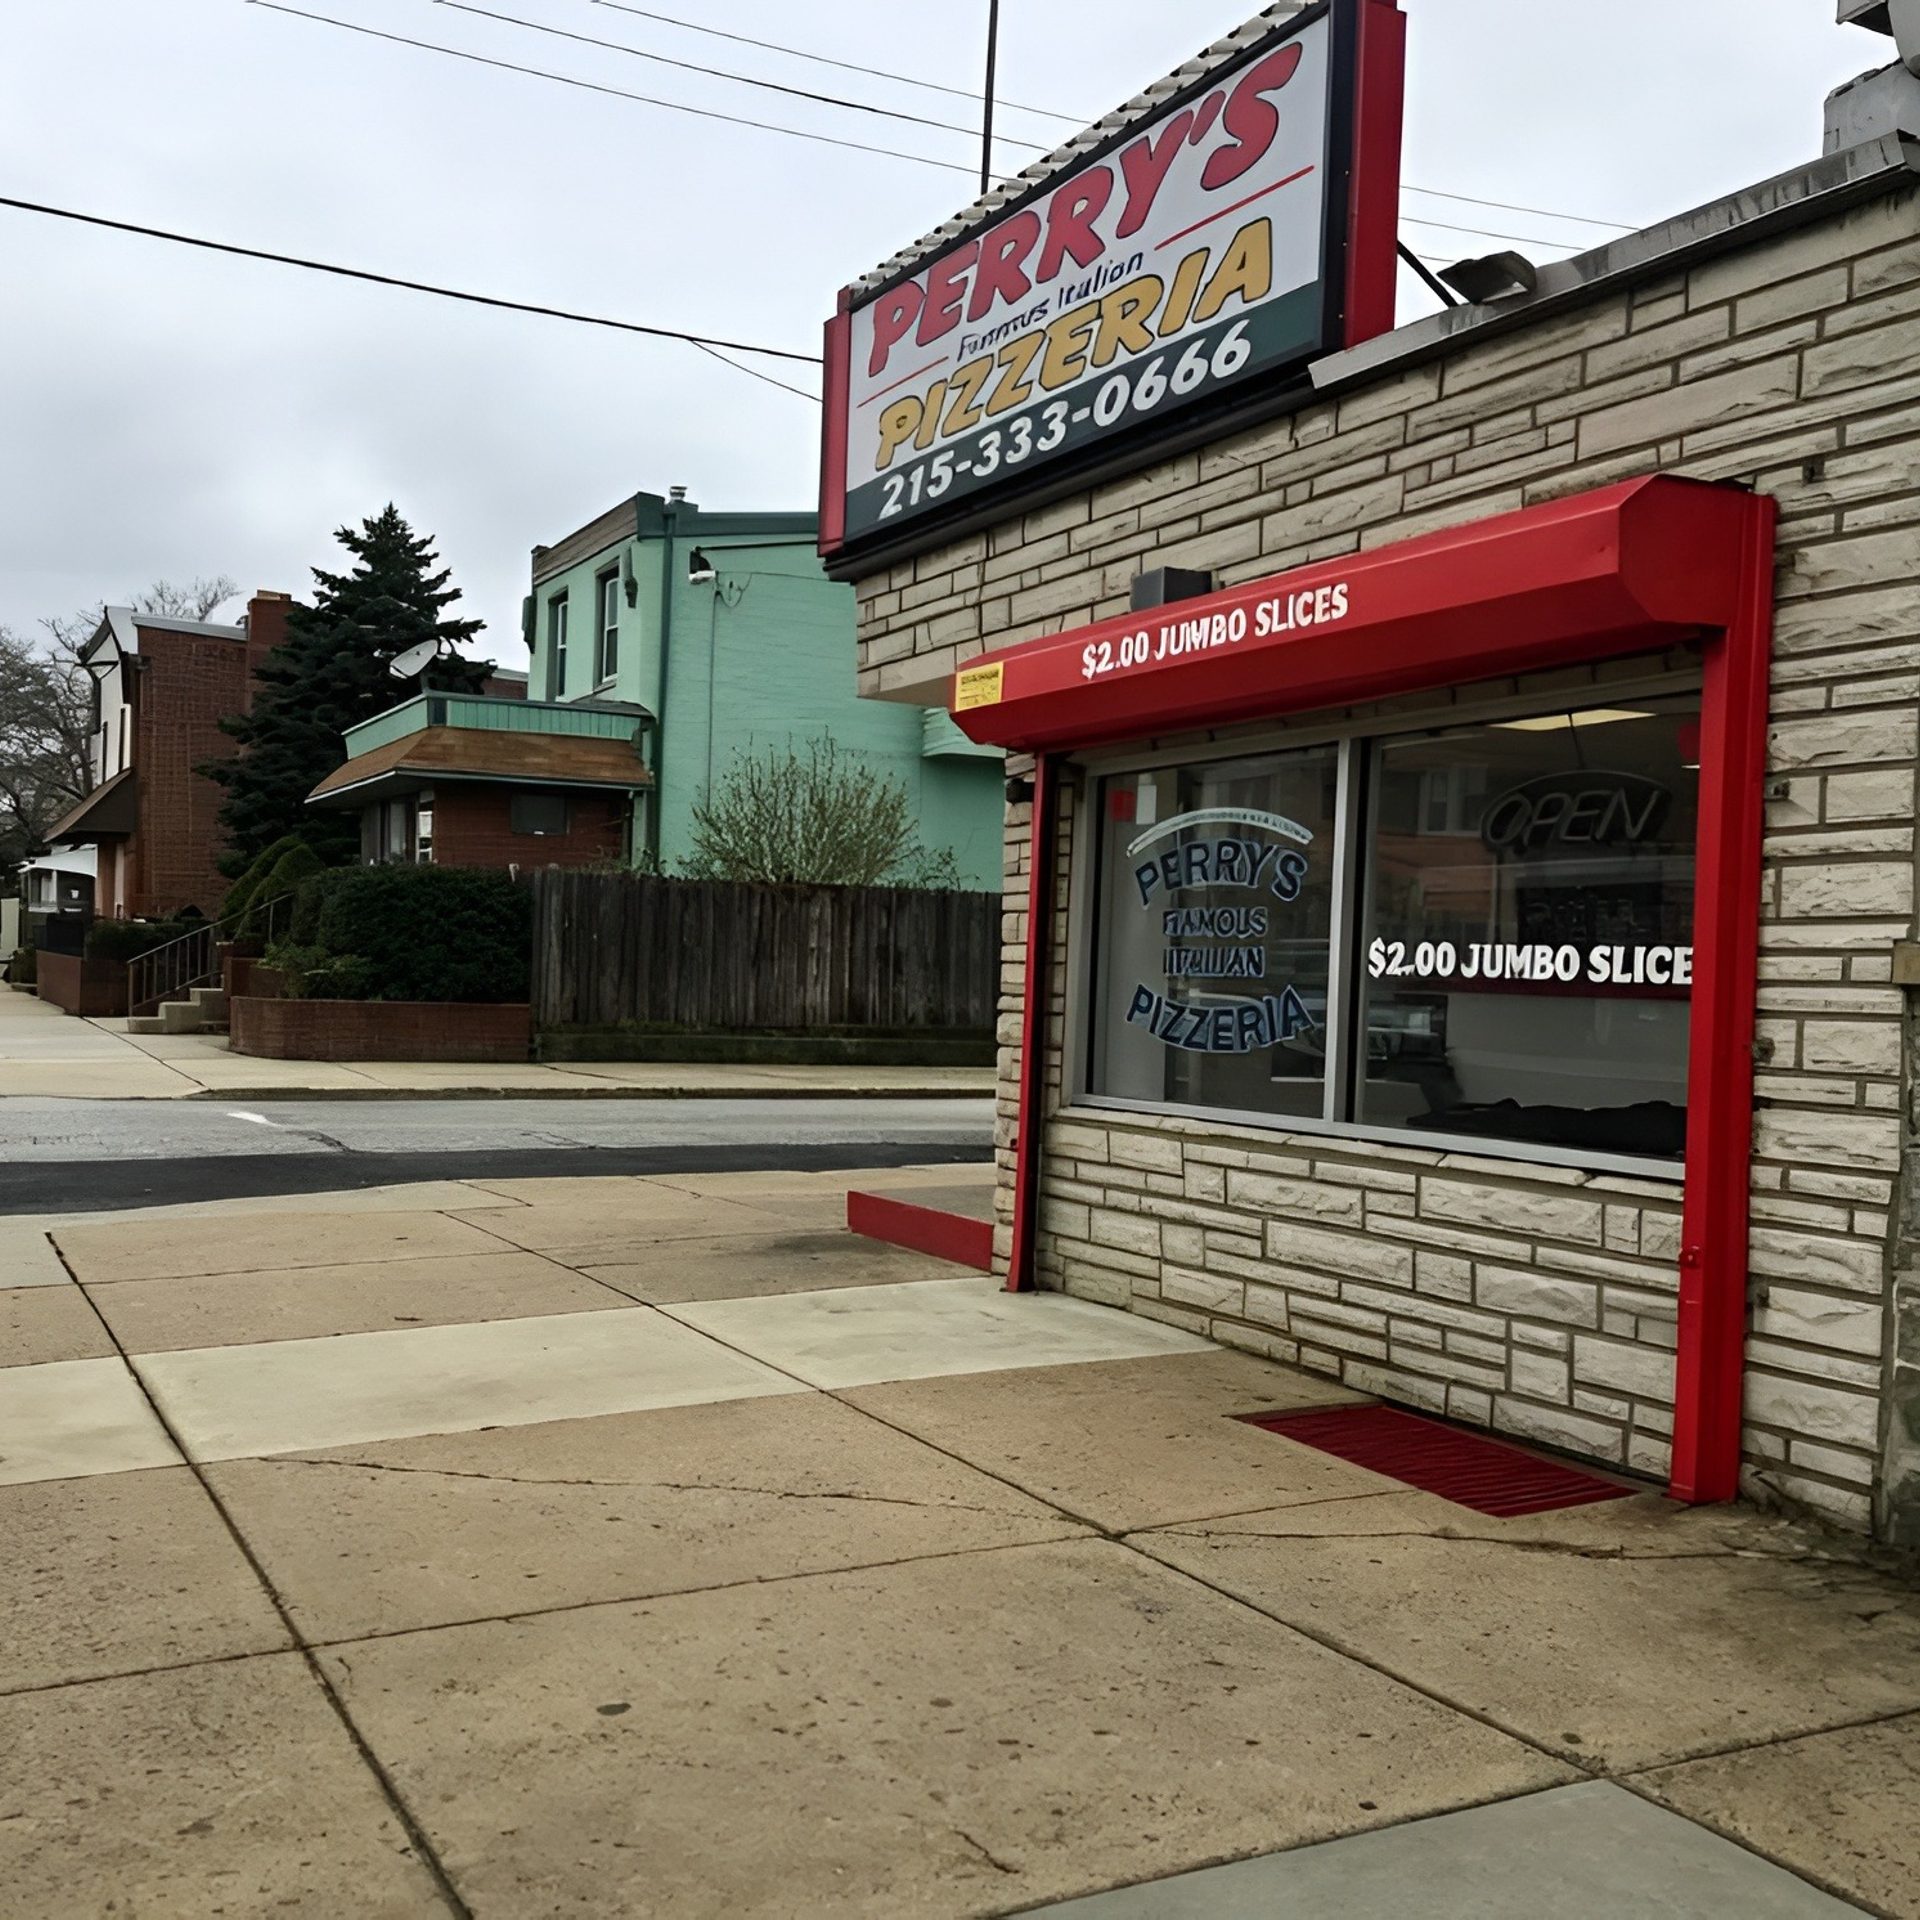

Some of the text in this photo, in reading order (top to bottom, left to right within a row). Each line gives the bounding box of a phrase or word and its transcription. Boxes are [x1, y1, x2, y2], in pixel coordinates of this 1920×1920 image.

[867, 41, 1303, 378] PERRY'S
[874, 216, 1273, 472] PIZZERIA
[876, 318, 1252, 523] 215-333-0666
[1081, 582, 1350, 681] $2.00 JUMBO SLICES
[1486, 786, 1662, 848] OPEN
[1134, 838, 1308, 911] PERRY'S
[1367, 936, 1457, 980] $2.00
[1460, 942, 1581, 982] JUMBO
[1126, 982, 1316, 1054] PIZZERIA
